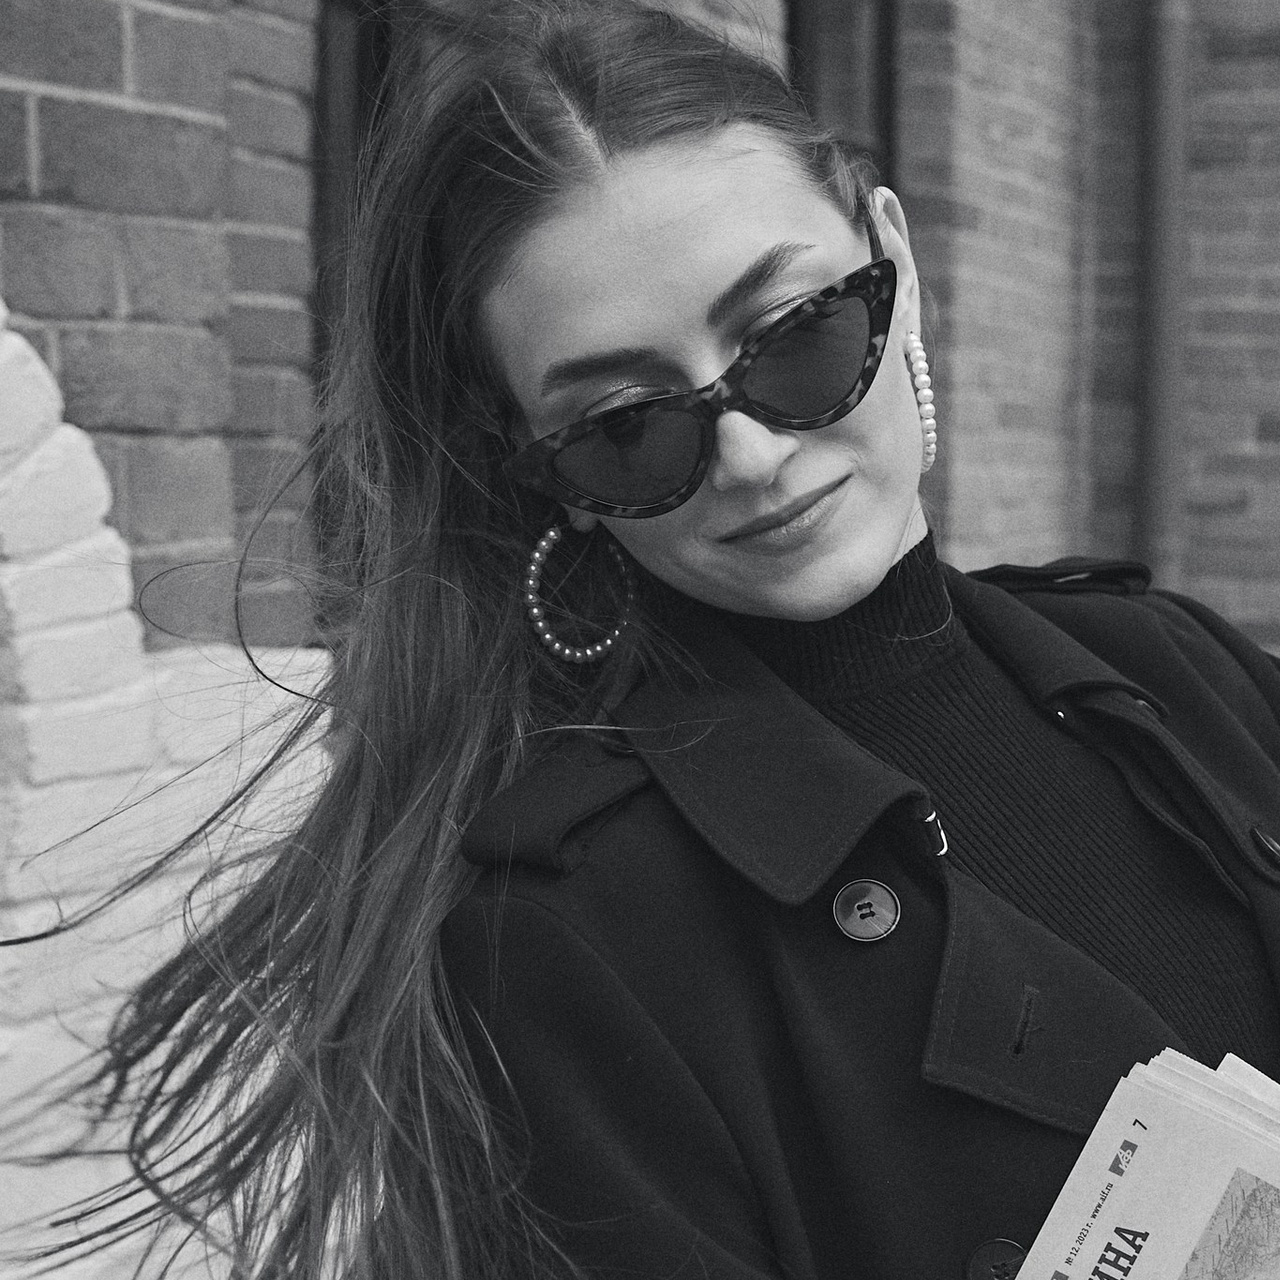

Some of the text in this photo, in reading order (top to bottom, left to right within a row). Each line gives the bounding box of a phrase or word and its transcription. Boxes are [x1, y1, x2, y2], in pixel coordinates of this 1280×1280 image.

[1132, 1118, 1148, 1131] 7
[1075, 1227, 1090, 1246] 2023
[1090, 1182, 1114, 1220] www.aif.ru
